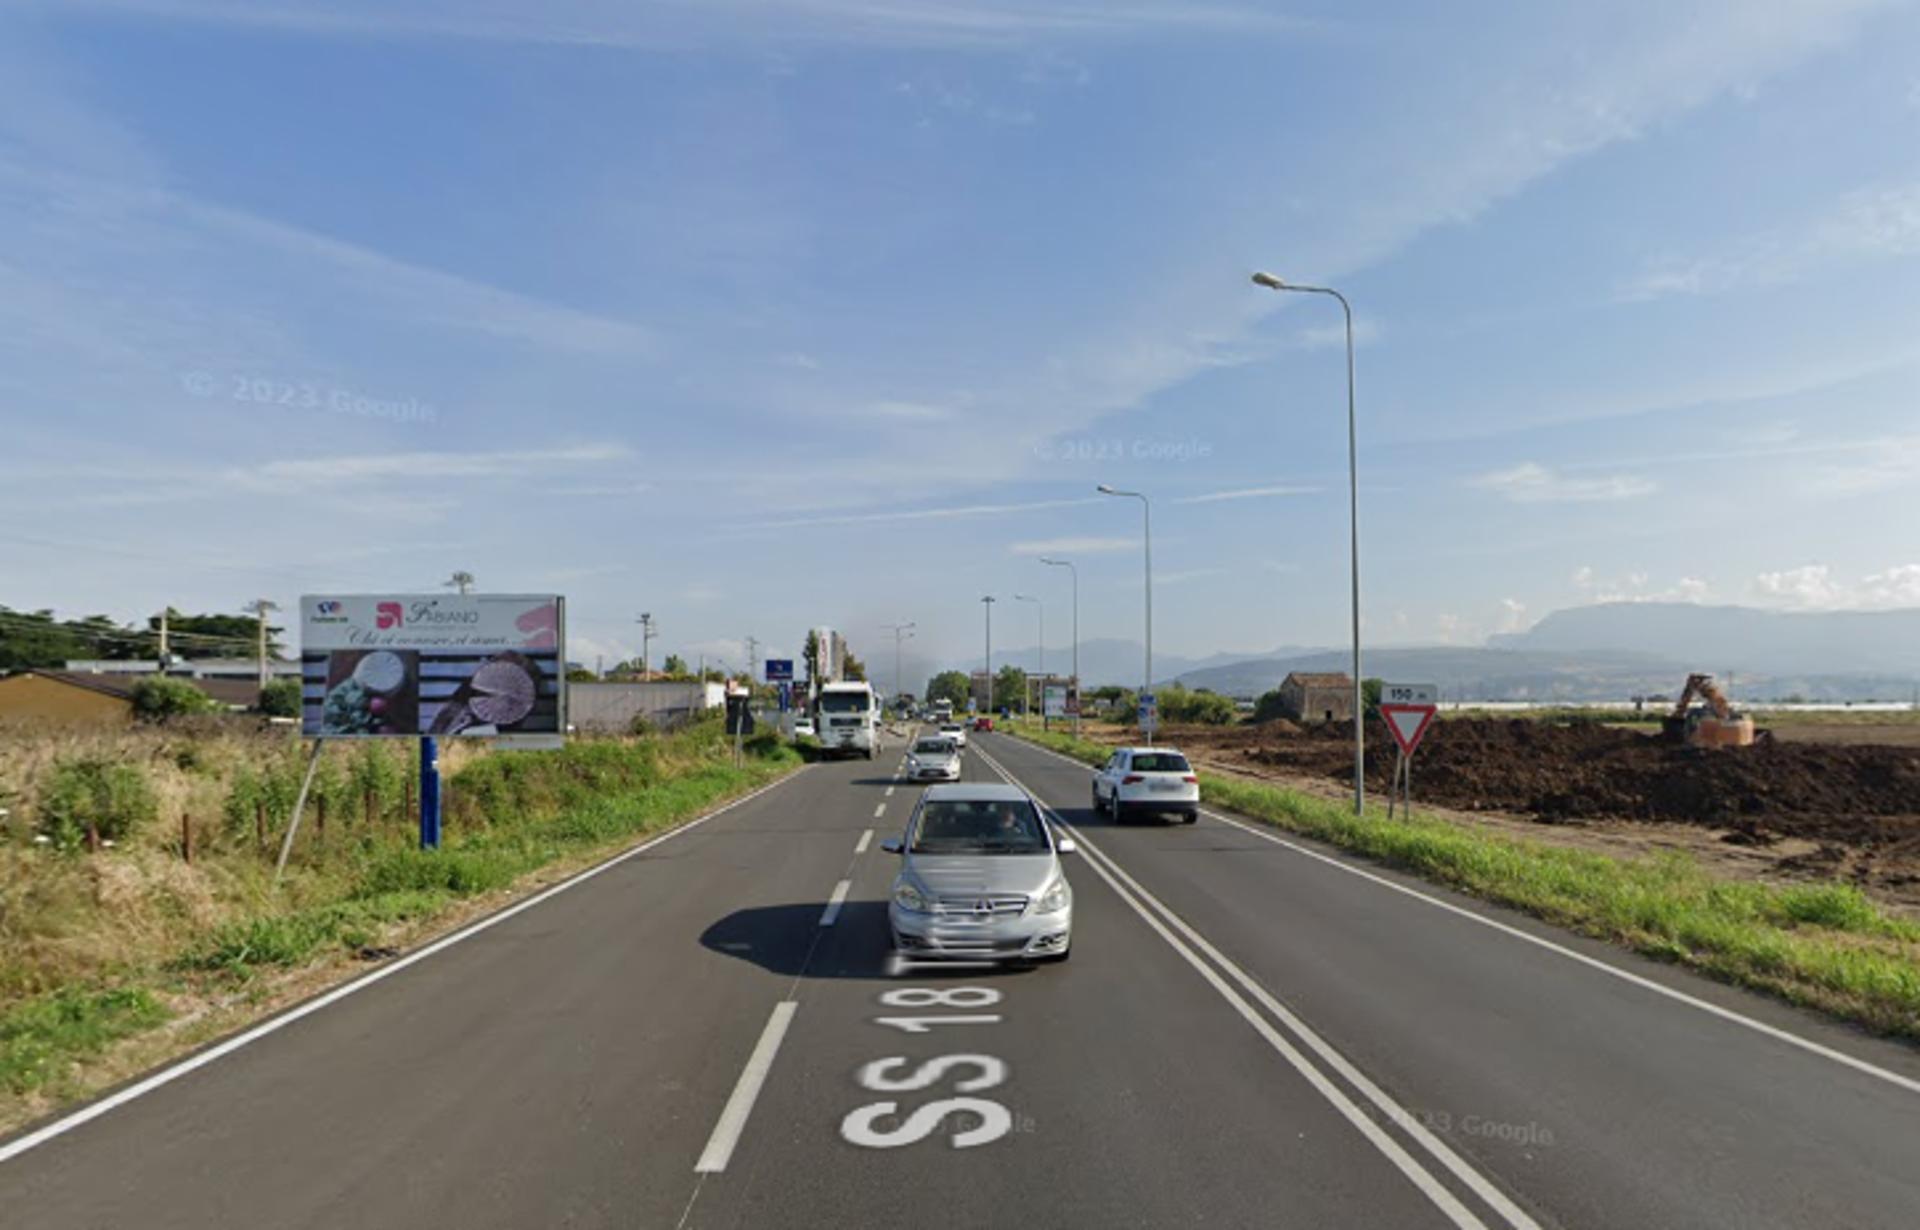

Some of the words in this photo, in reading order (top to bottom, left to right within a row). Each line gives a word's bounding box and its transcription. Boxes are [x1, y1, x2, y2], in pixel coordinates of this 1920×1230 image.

[1391, 688, 1413, 700] 150
[872, 986, 1003, 1033] 18
[839, 1052, 1013, 1148] SS
